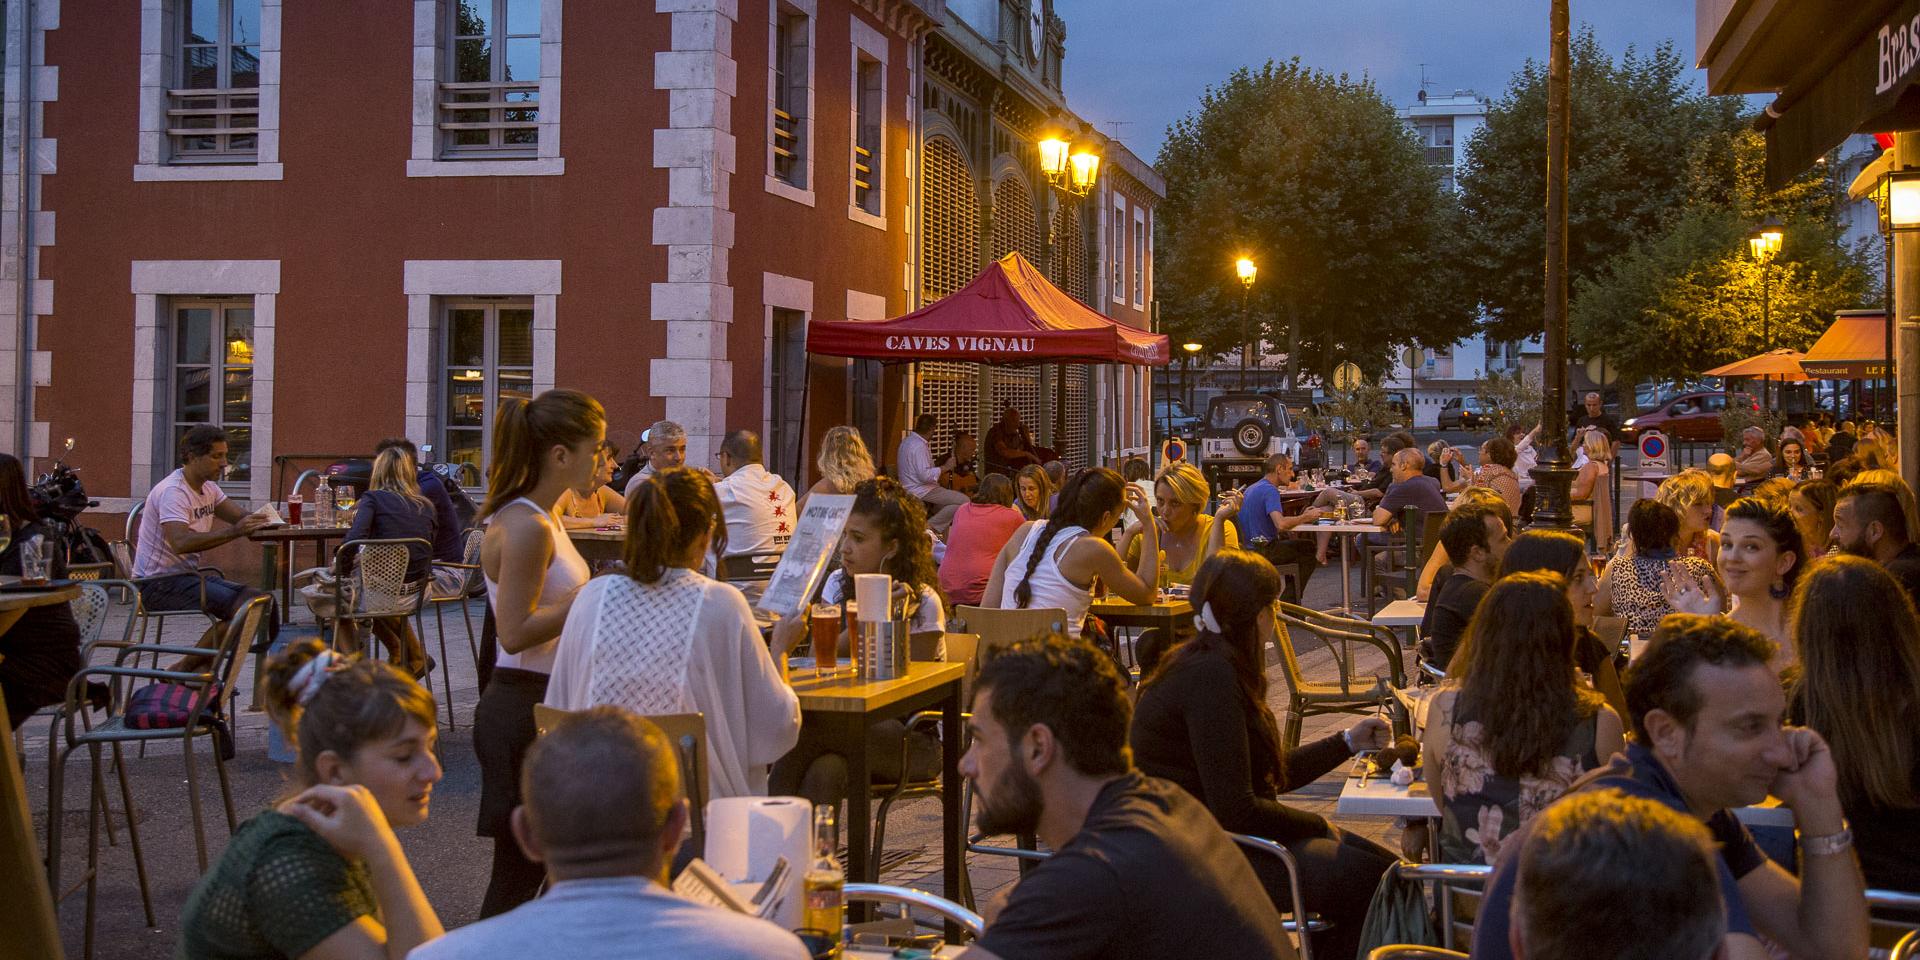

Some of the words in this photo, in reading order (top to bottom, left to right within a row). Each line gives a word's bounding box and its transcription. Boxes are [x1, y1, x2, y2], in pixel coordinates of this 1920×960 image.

[1876, 14, 1920, 95] Bras
[885, 335, 950, 351] CAVES
[956, 337, 1035, 352] VIGNAU
